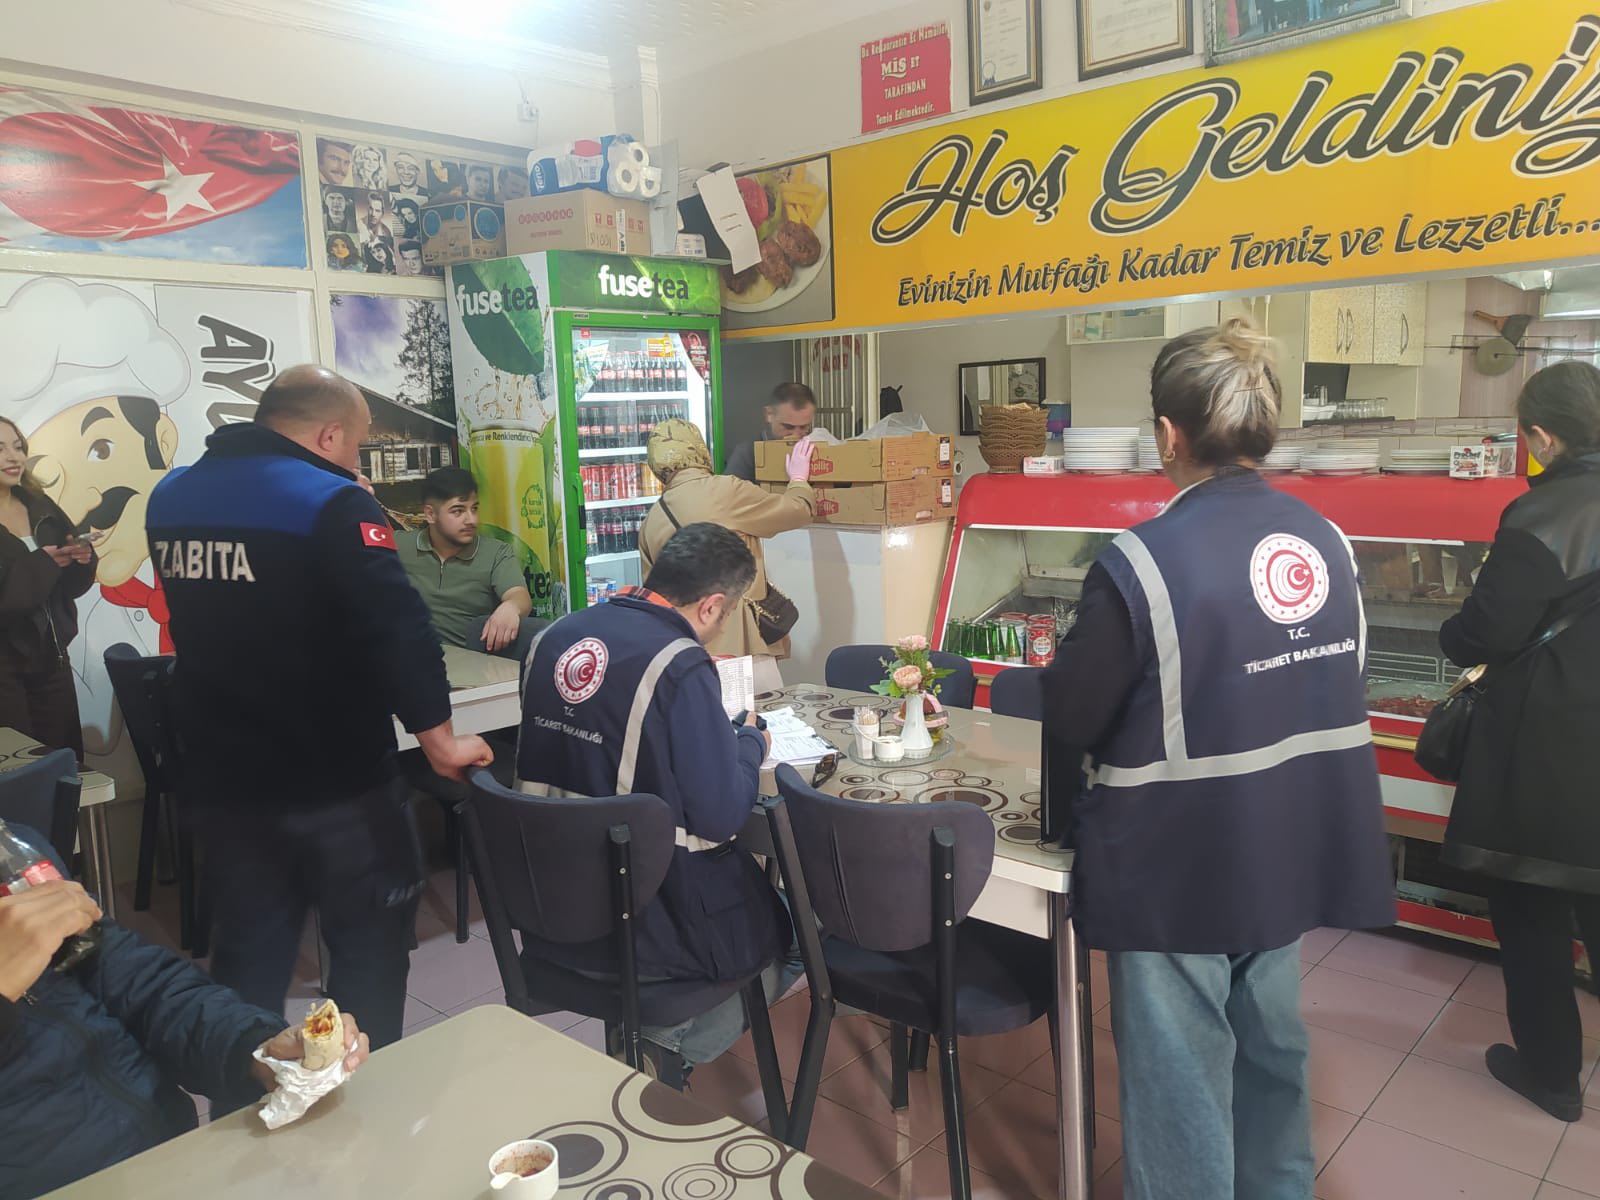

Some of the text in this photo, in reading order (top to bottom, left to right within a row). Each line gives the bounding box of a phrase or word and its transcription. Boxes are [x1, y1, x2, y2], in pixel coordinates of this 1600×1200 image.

[911, 56, 920, 68] ET
[884, 79, 926, 99] TARAFINDAN
[870, 129, 1080, 245] Hoş
[898, 268, 991, 307] Evinizin
[998, 254, 1110, 295] Mutfağı
[1118, 243, 1220, 283] Kadar
[1230, 225, 1332, 271] Temiz
[1340, 227, 1384, 257] ve
[154, 540, 256, 582] ZABITA
[1287, 626, 1310, 640] T.C.
[1242, 638, 1355, 674] TİCARET BAKANLIĞI
